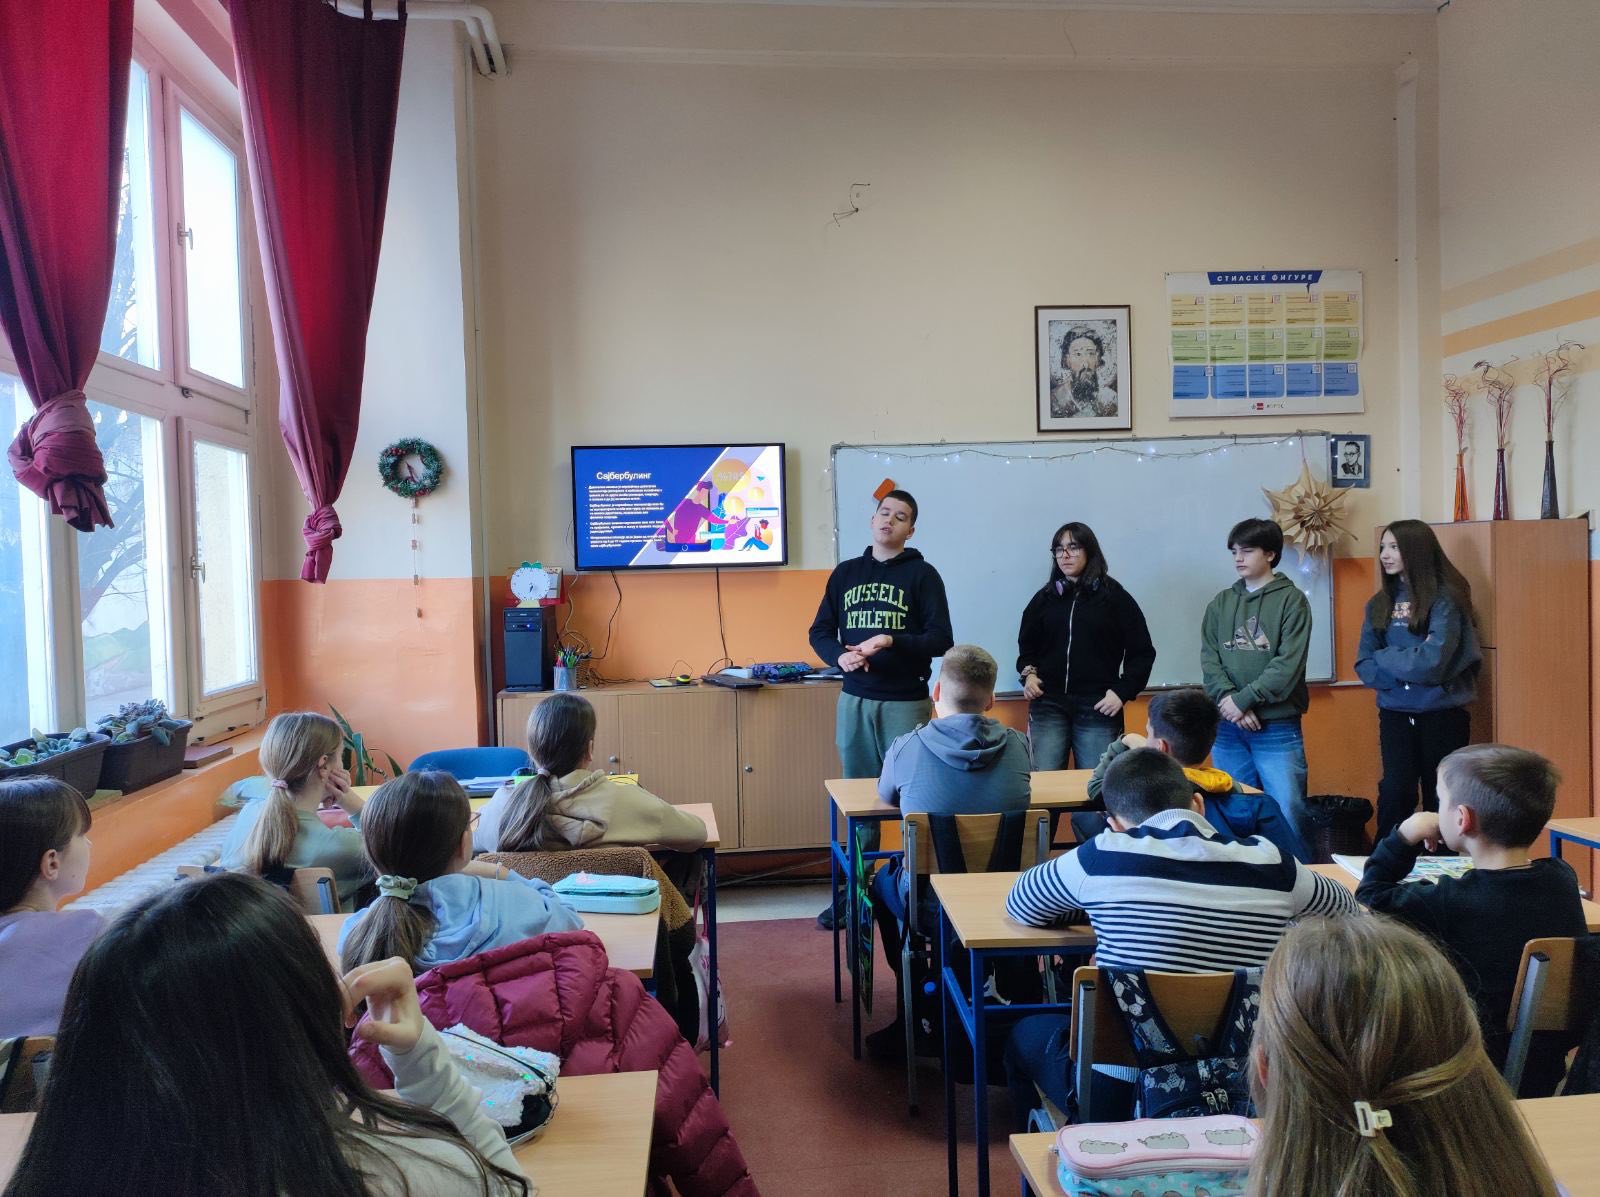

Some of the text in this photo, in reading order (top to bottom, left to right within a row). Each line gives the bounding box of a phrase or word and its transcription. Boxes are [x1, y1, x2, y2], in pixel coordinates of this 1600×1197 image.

[1216, 273, 1313, 282] СТИЛСКЕ ФИГУРЕ
[596, 471, 652, 481] Сајбербулинг
[843, 582, 909, 612] RUSSELL
[846, 610, 906, 630] ATHLETIC
